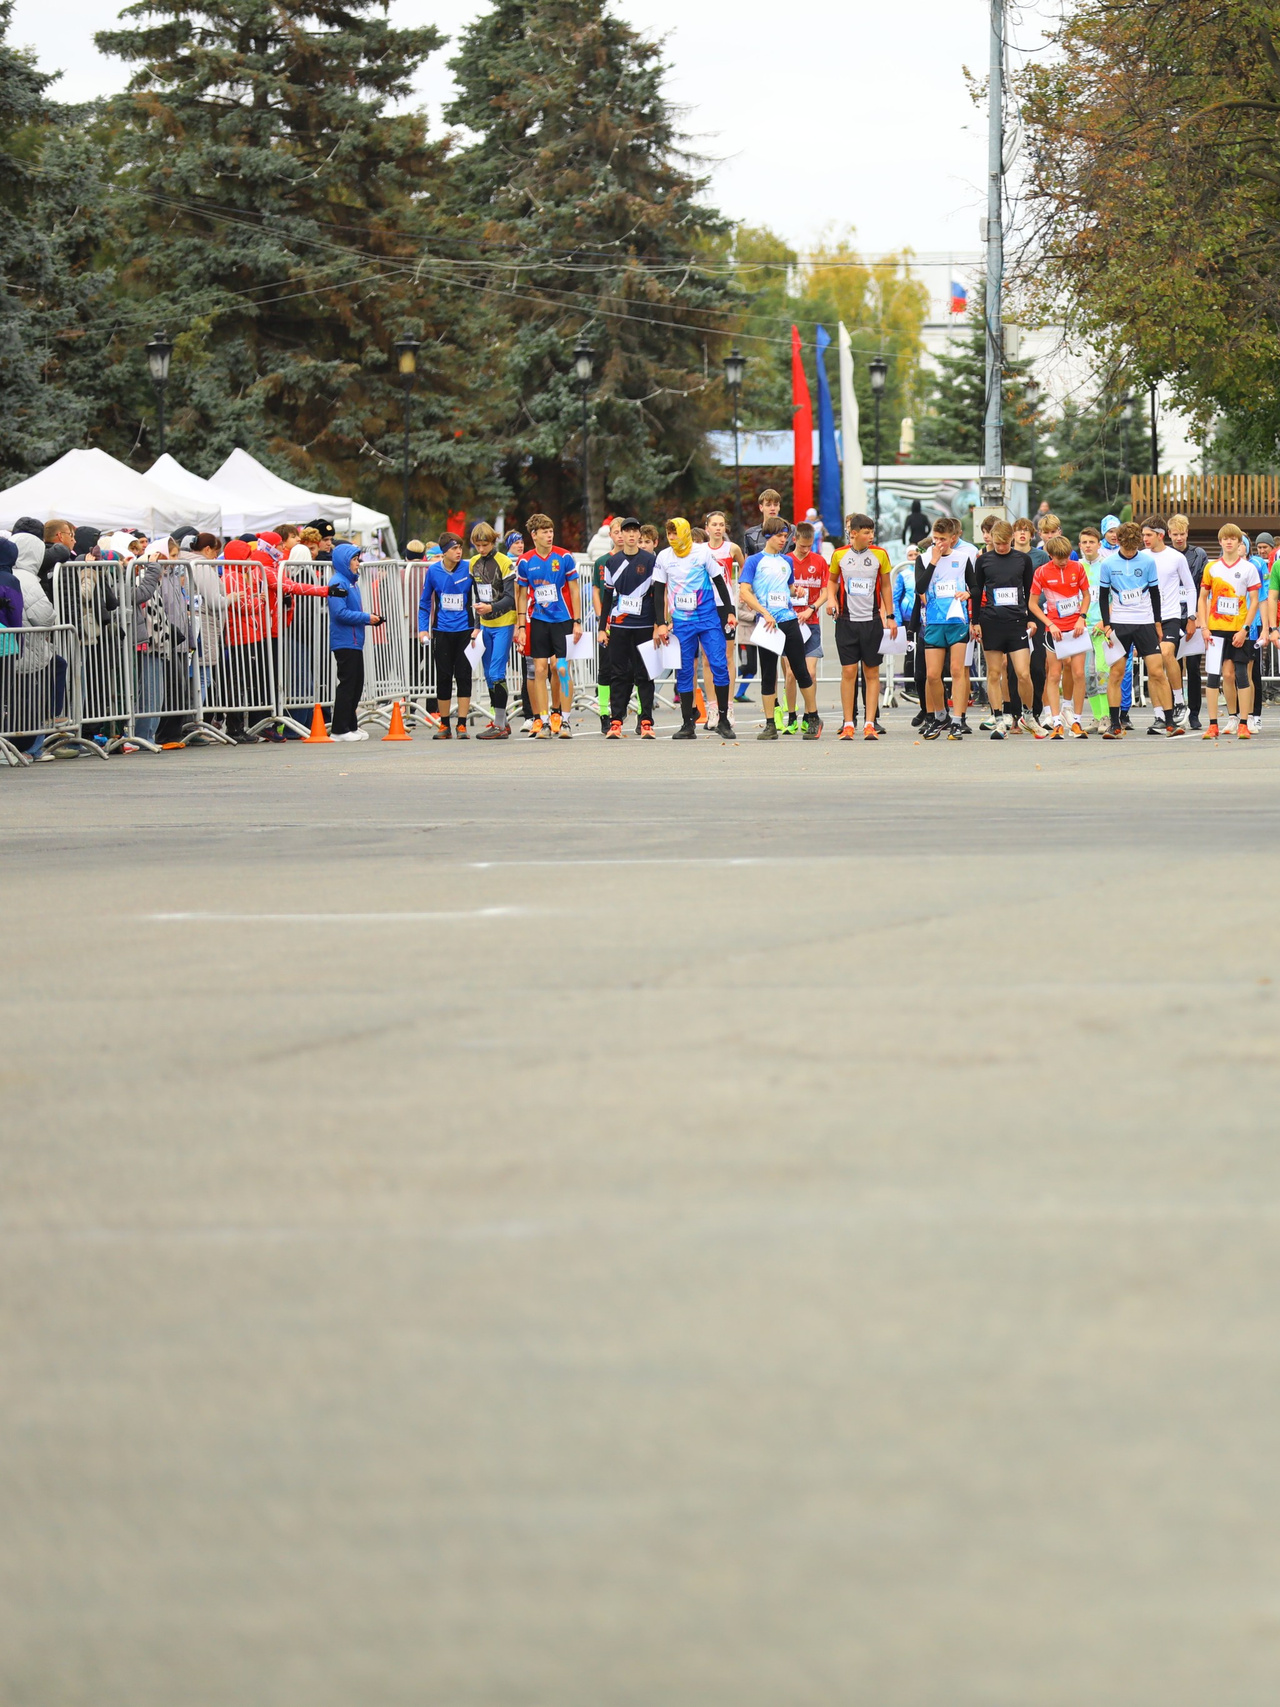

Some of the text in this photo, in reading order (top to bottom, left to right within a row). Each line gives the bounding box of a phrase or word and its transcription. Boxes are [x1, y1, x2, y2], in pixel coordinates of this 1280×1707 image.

[1123, 591, 1140, 600] 310.1
[622, 599, 639, 607] 303.1
[1060, 601, 1076, 610] 309.1
[1220, 600, 1235, 608] 311.1
